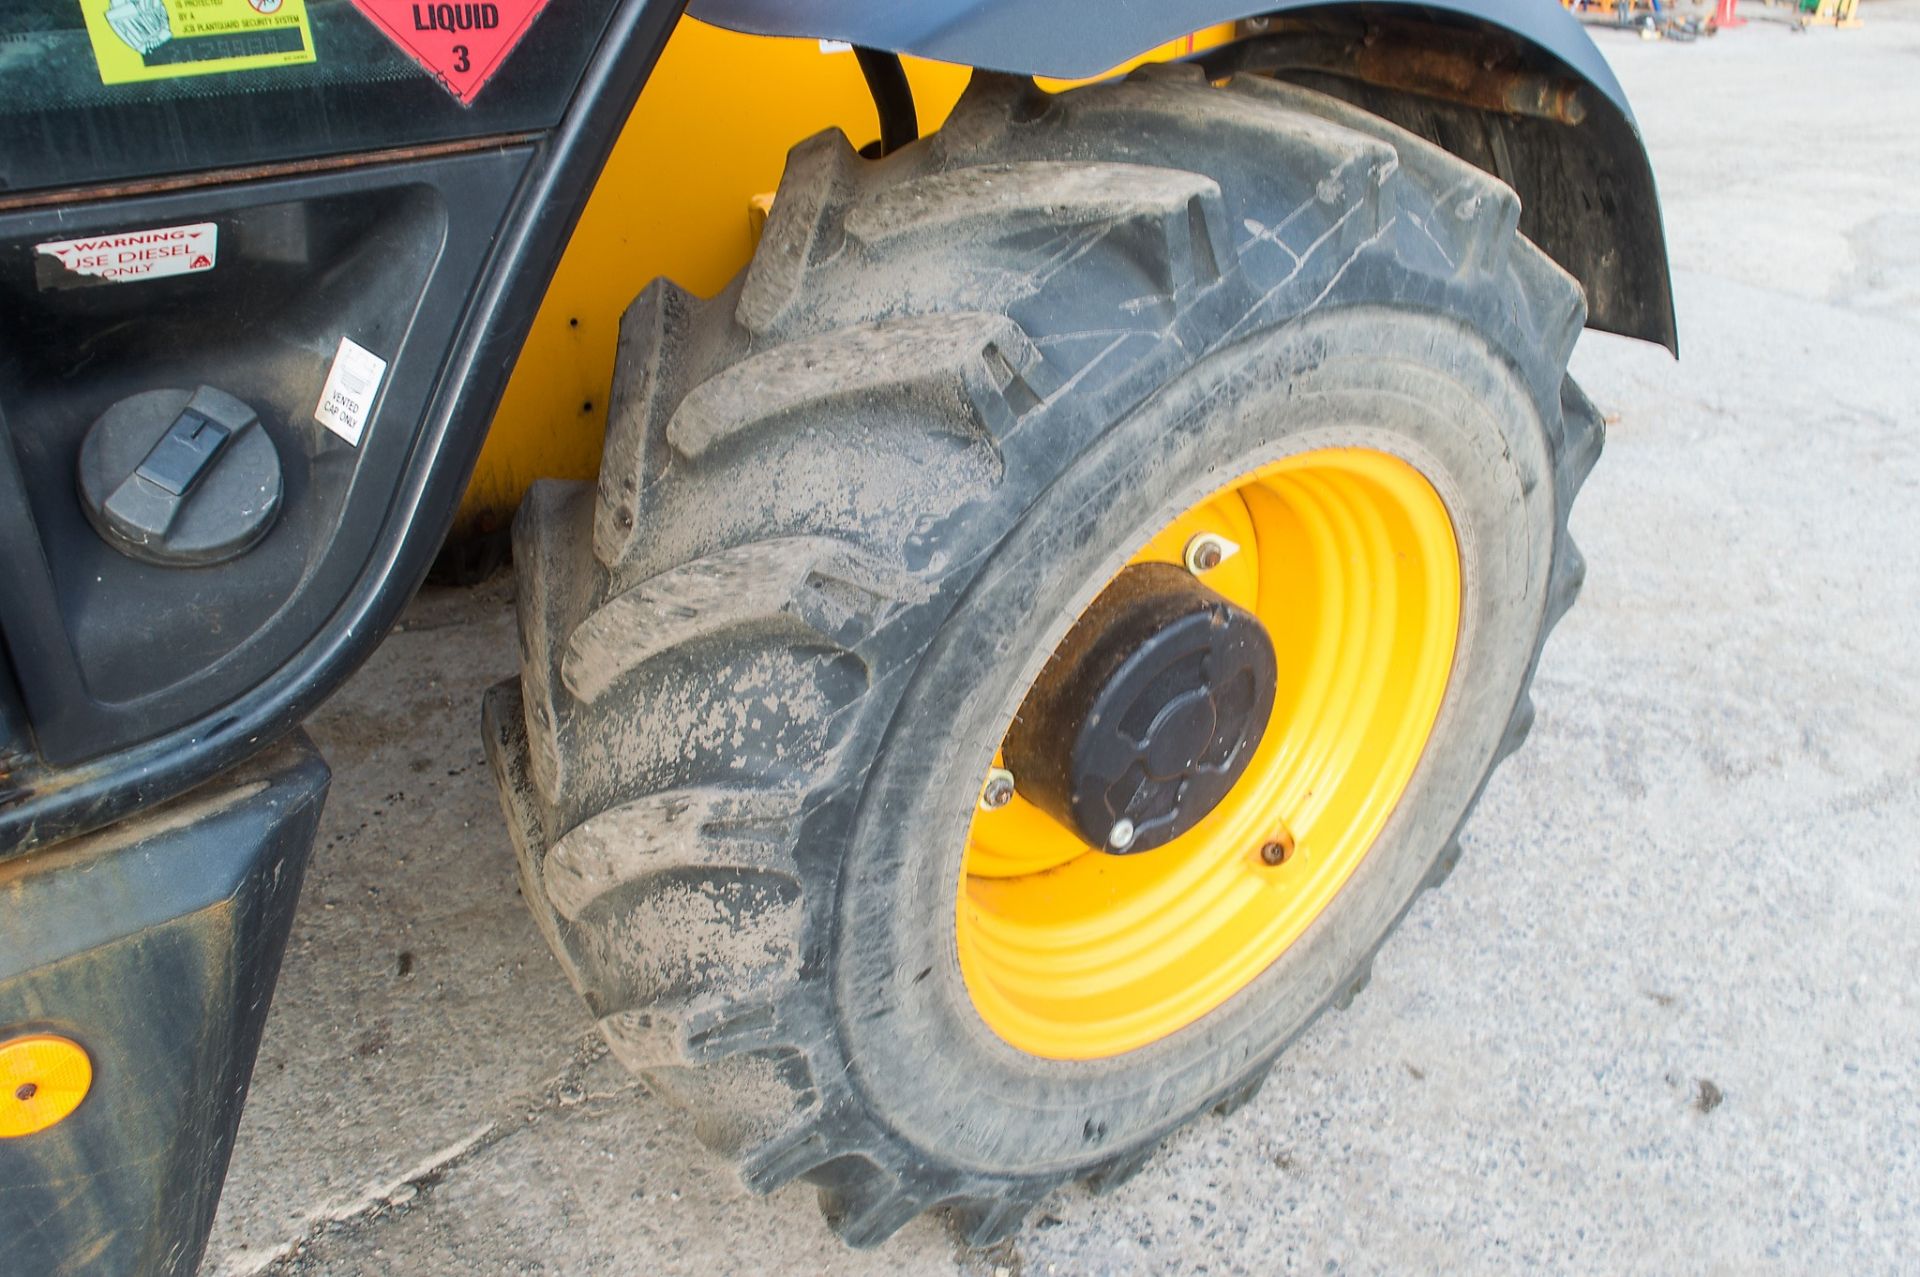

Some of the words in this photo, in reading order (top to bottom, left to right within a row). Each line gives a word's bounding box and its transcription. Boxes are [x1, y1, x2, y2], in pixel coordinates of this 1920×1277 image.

[179, 12, 187, 21] BY
[183, 24, 195, 33] JCB
[197, 20, 240, 31] PLANTGUARD
[241, 17, 272, 28] SECURITY
[275, 15, 300, 25] SYSTEM
[412, 4, 499, 33] LIQUID
[452, 45, 470, 72] 3
[74, 230, 185, 252] WARNING
[63, 254, 109, 270] USE
[118, 244, 196, 264] DIESEL
[102, 263, 154, 278] ONLY
[333, 390, 359, 414] VENTED
[324, 401, 340, 416] CAP
[340, 411, 357, 428] ONLY
